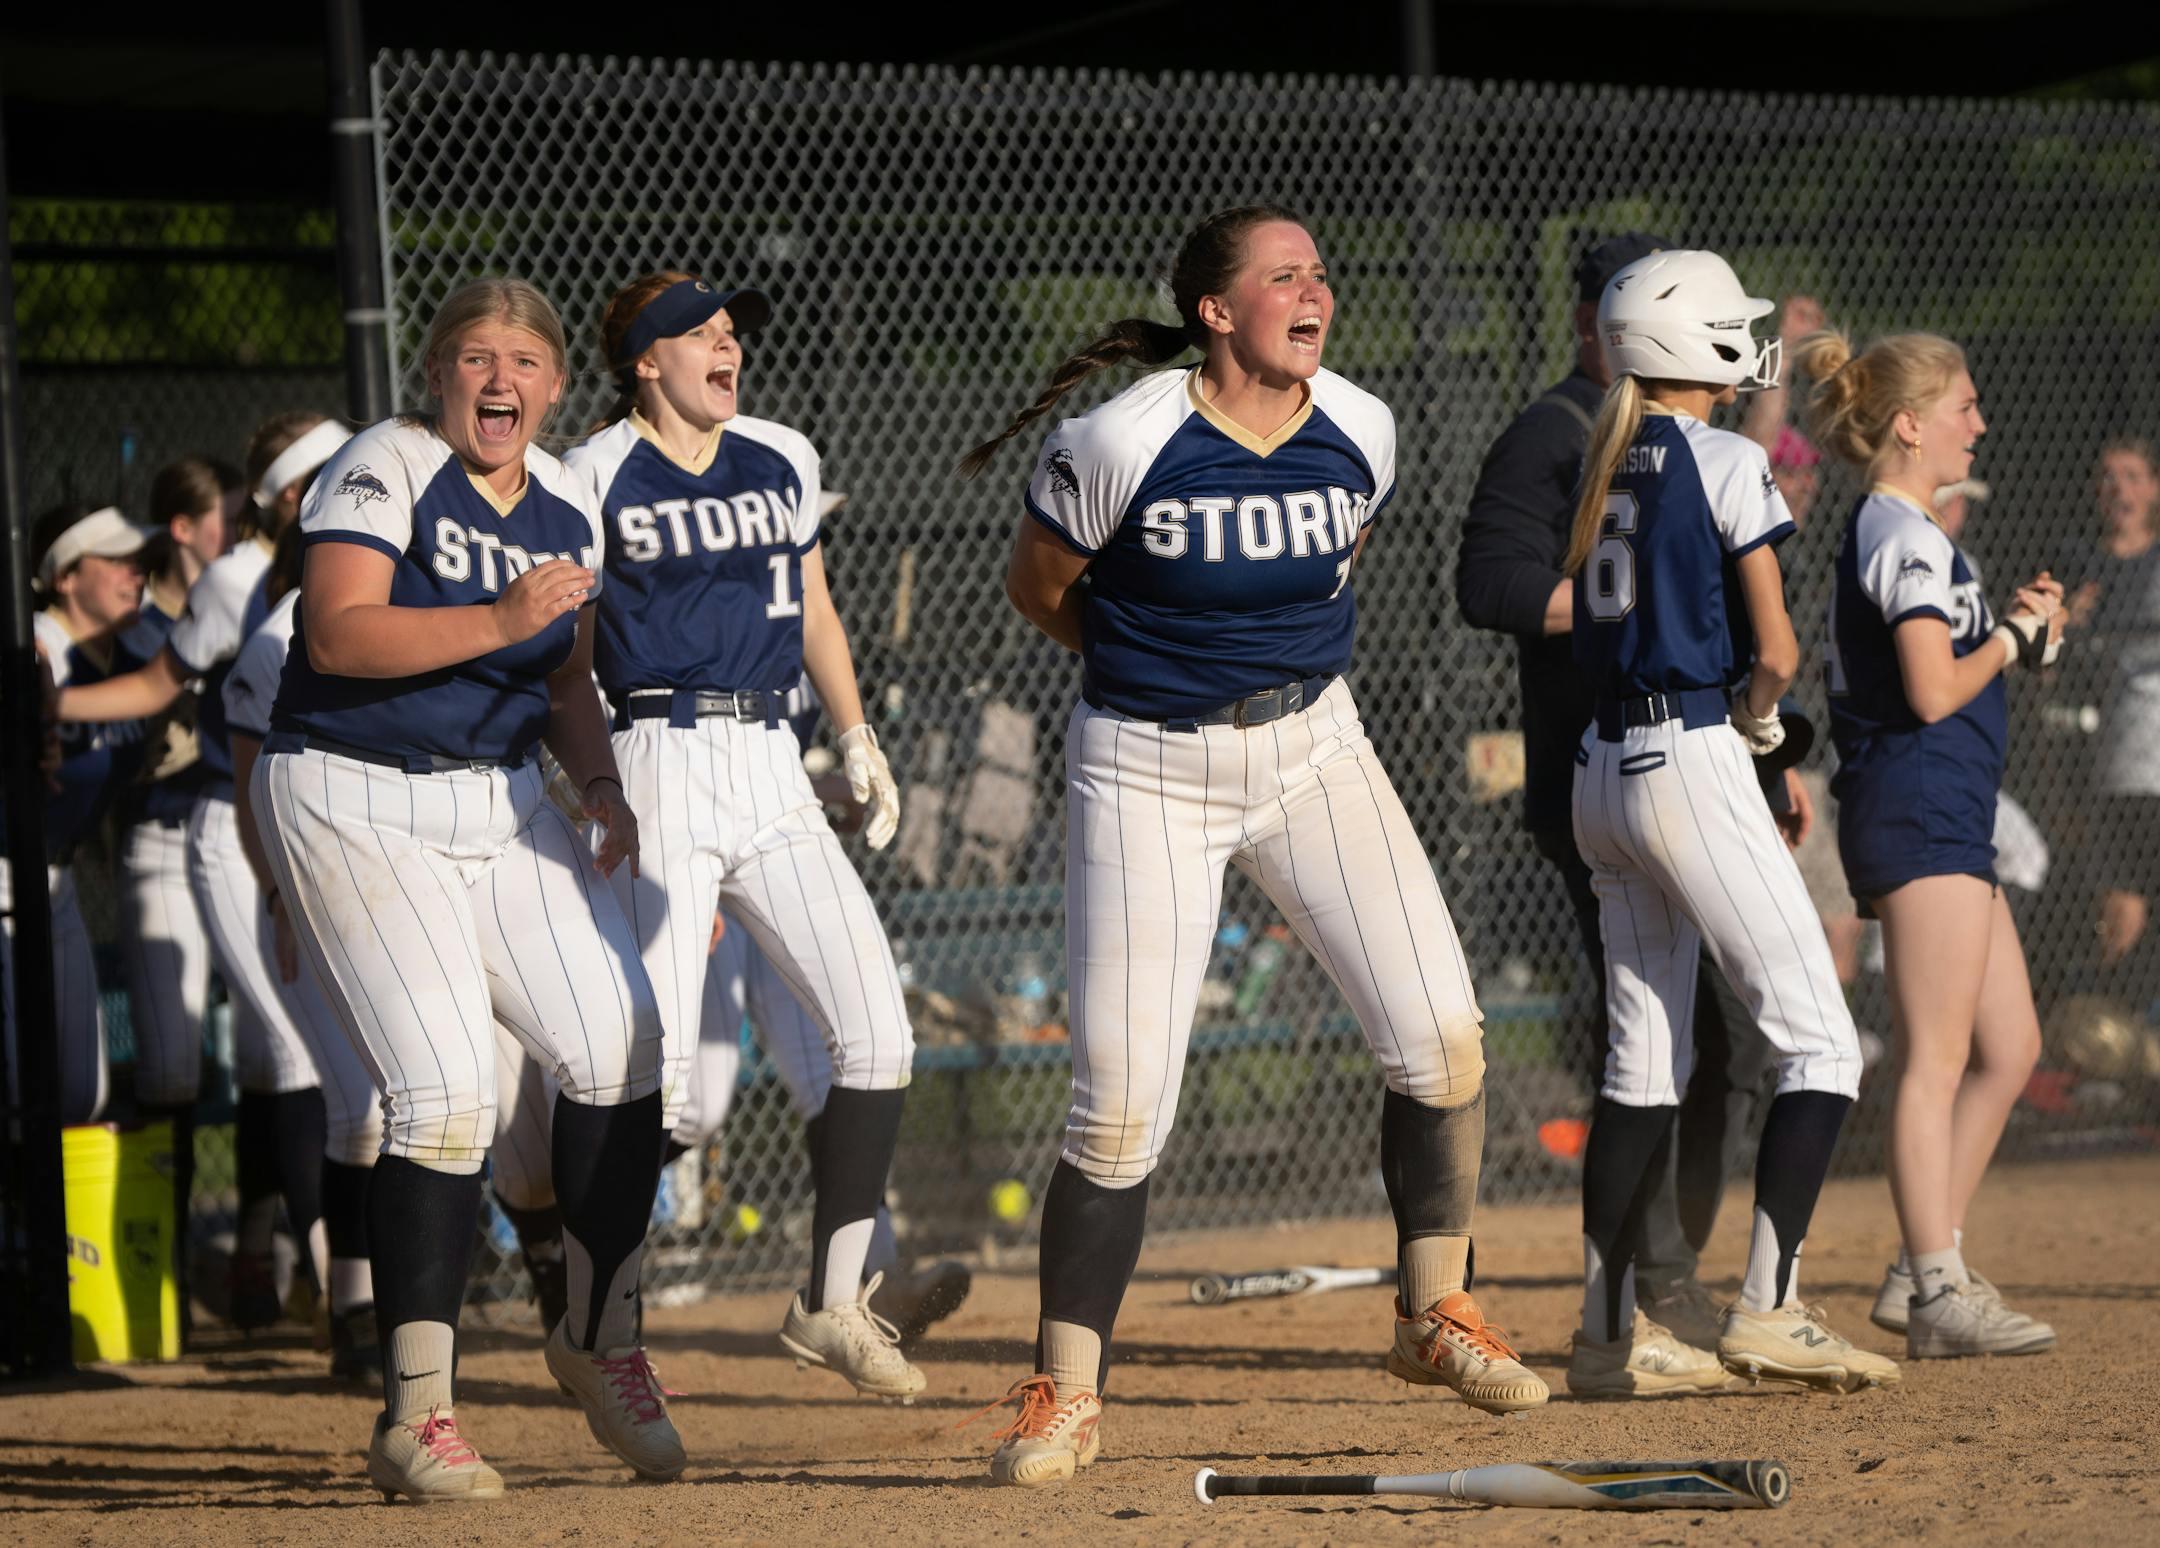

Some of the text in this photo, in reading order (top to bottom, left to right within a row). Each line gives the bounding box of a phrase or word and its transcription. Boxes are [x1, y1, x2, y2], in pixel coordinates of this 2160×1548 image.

[333, 484, 391, 510] STORM
[1043, 458, 1081, 499] STORM
[432, 516, 593, 593] STO
[1142, 485, 1369, 562] STORM
[1585, 489, 1640, 622] 6
[766, 553, 801, 619] 1
